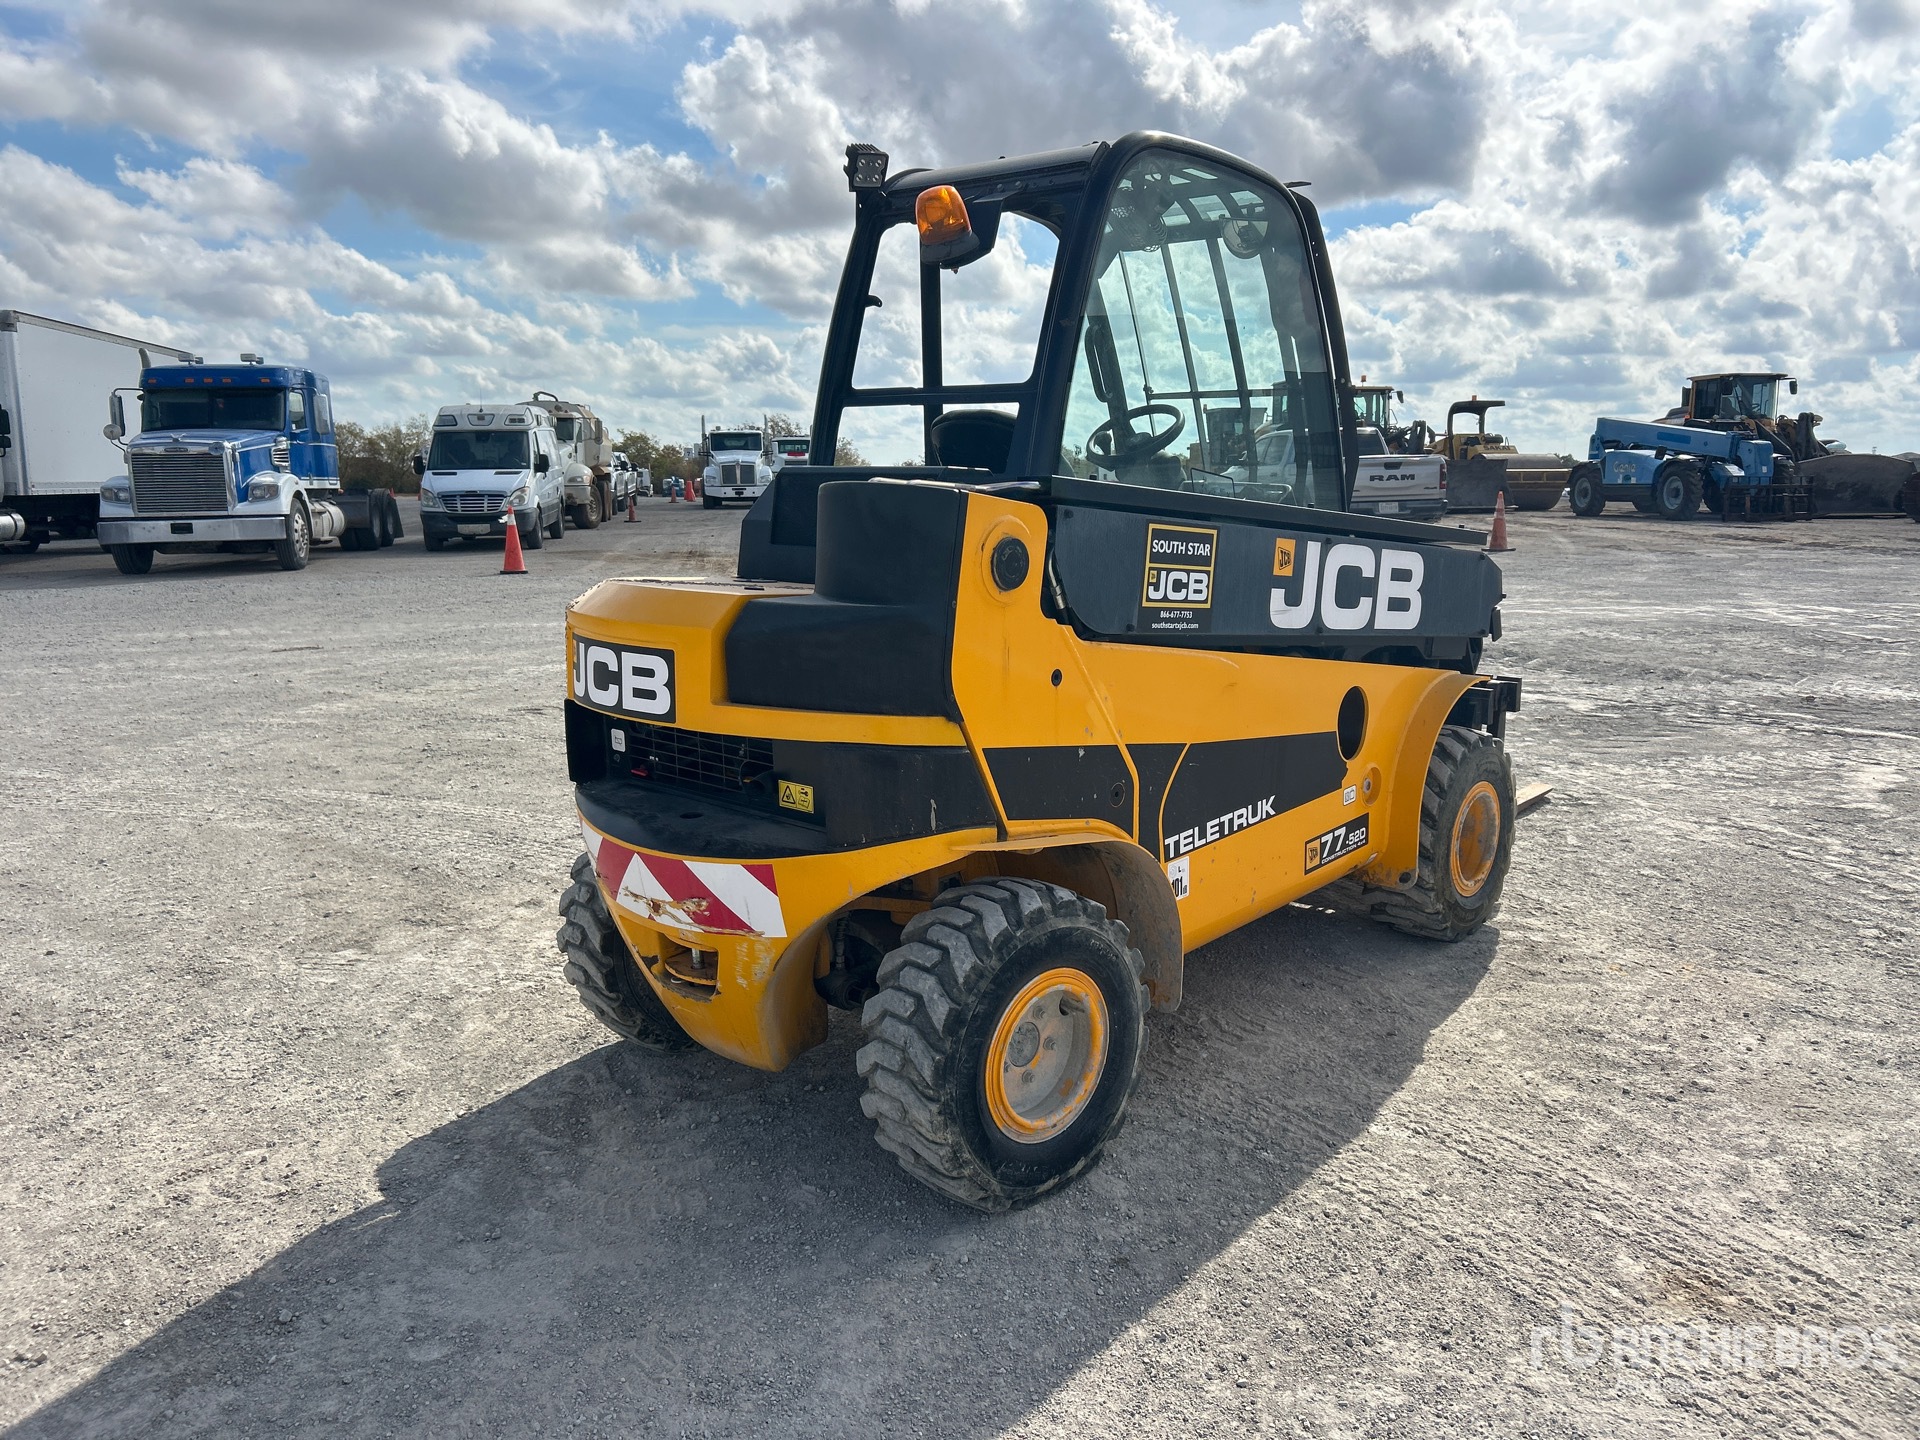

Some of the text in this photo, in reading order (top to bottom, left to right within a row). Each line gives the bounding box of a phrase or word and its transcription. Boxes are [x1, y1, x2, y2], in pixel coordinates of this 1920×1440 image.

[1613, 461, 1636, 473] Genie
[1369, 474, 1416, 482] RAM
[1152, 539, 1211, 556] SOUTH STAR
[1148, 570, 1209, 601] JCB
[1269, 540, 1425, 630] JCB
[1160, 610, 1193, 619] 866-677-7753
[1151, 621, 1199, 631] southstartxjcb.com
[573, 642, 671, 715] JCB
[1164, 795, 1276, 859] TELETRUK
[1321, 843, 1357, 865] CONSTRUCTION
